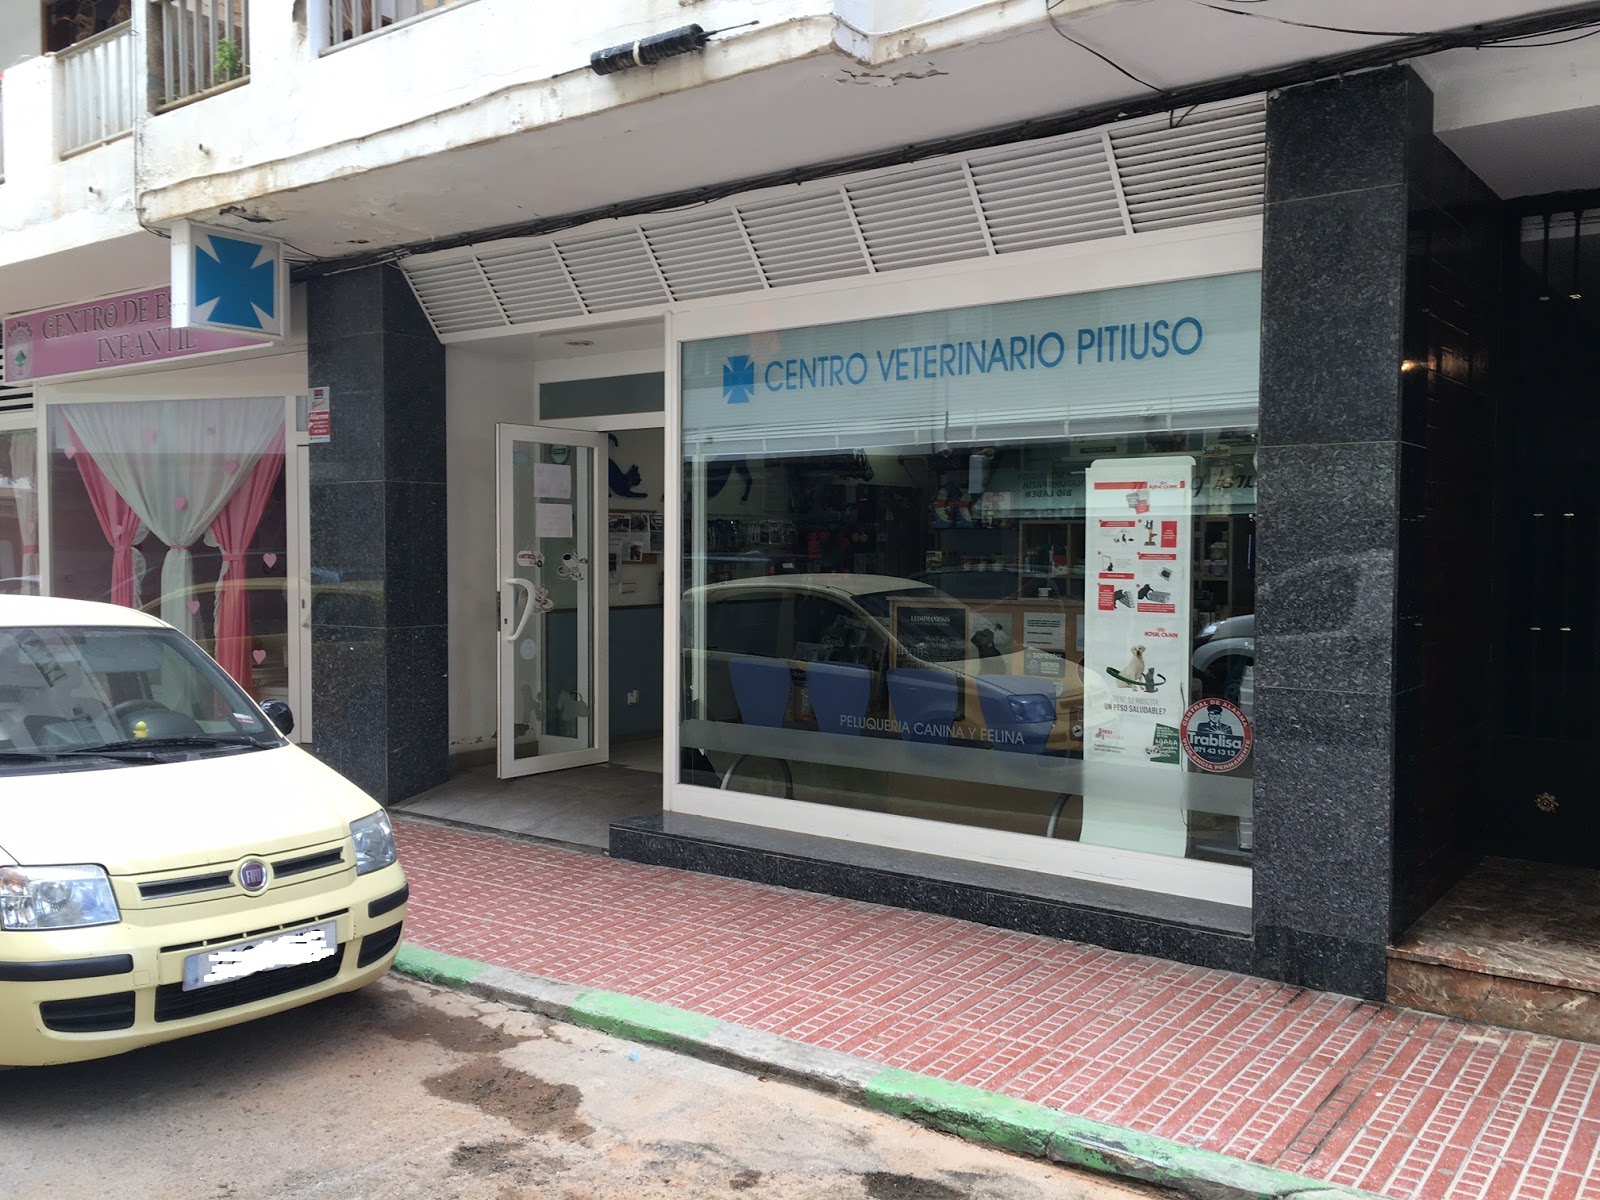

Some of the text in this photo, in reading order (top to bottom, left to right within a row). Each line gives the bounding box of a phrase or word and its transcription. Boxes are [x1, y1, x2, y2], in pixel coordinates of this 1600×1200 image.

[42, 303, 118, 340] CENTRO
[123, 297, 148, 325] DE
[97, 327, 196, 363] INFANTIL
[765, 316, 1203, 392] CENTRO VETERINARIO PITIUSO
[1113, 703, 1128, 712] PESO
[1129, 705, 1166, 715] SALUDABLE?
[1182, 700, 1208, 726] CENTRAL
[1222, 702, 1248, 727] ALARMA
[840, 714, 1025, 745] PELUQUERIA CANINA Y FELINA
[1188, 731, 1242, 749] Trablisa
[1182, 738, 1251, 770] VIGILANCIA PERMANENTE
[246, 868, 261, 883] FIAT
